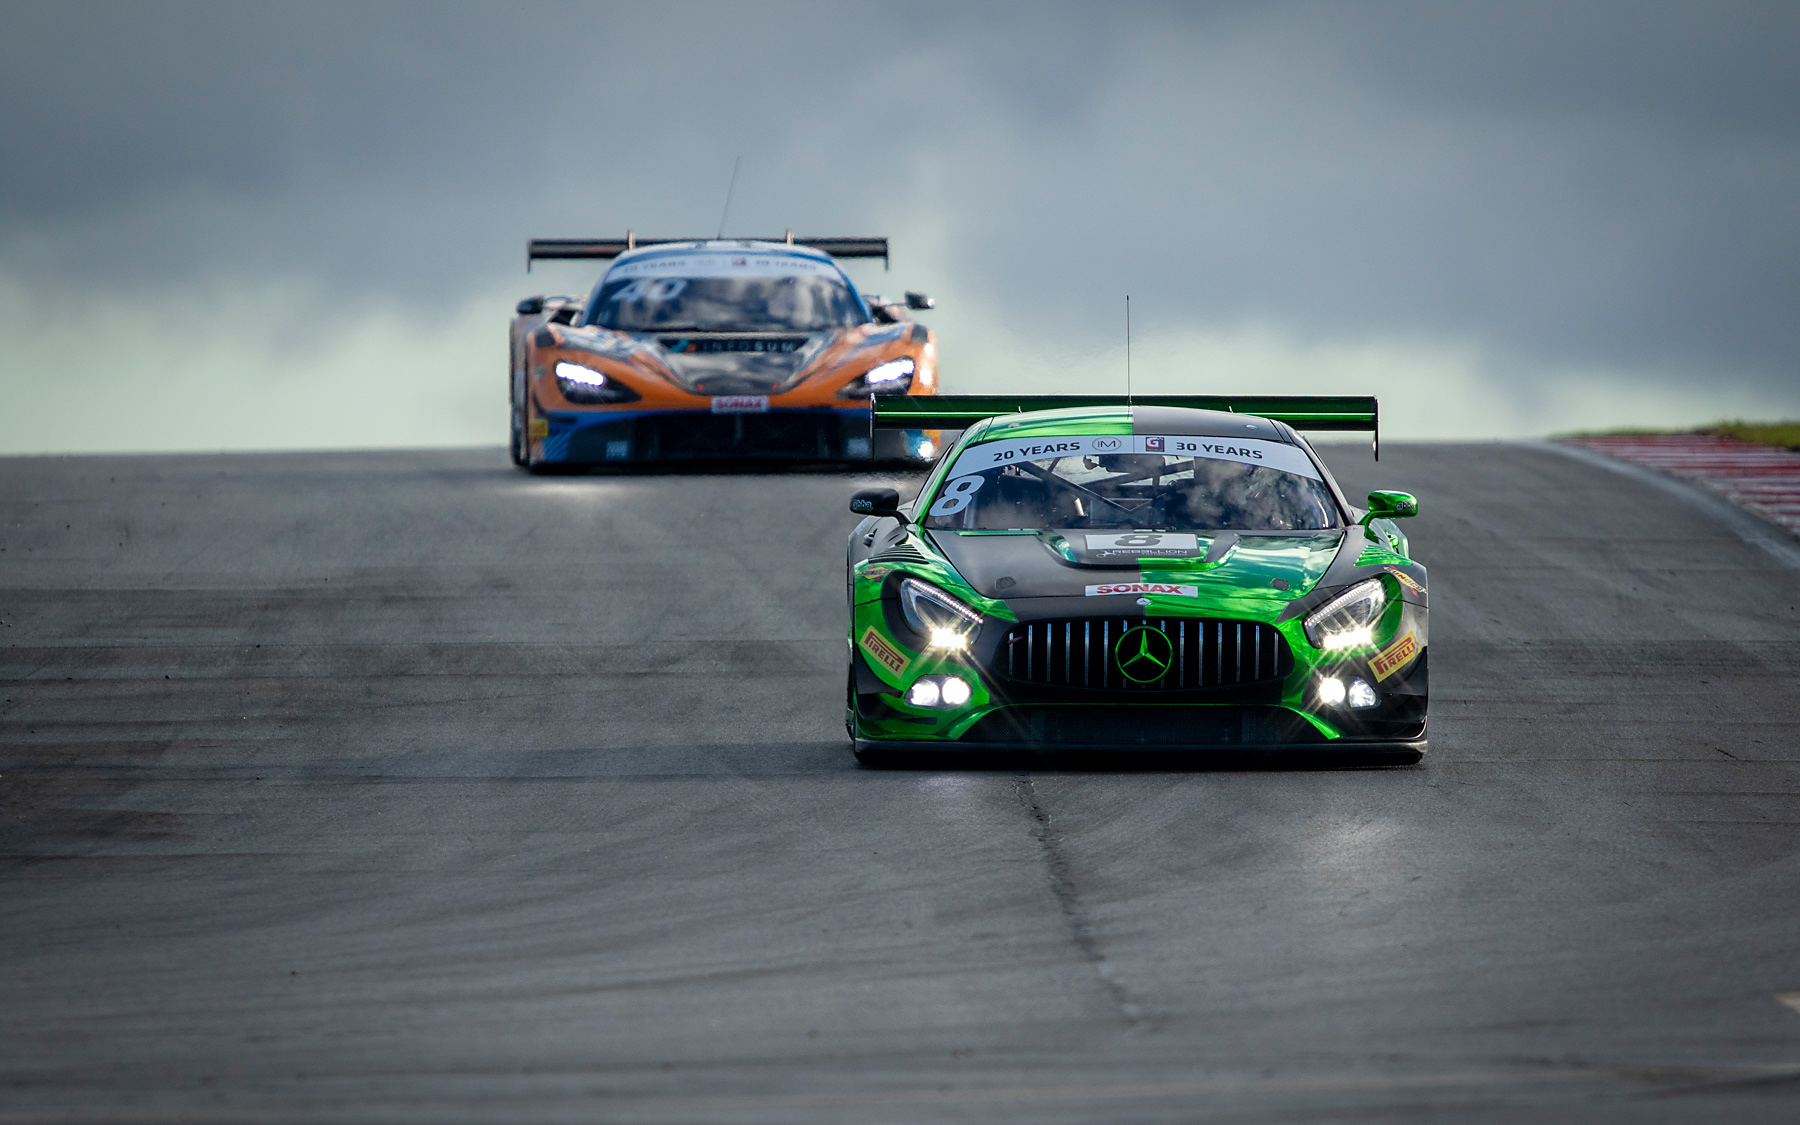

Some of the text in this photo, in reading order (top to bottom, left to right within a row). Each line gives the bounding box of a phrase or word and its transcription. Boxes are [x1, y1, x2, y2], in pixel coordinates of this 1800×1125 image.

[702, 340, 795, 352] INFOSUM
[993, 441, 1081, 462] 20 YEARS
[1176, 442, 1263, 459] 30 YEARS
[929, 475, 985, 516] 8
[1114, 534, 1163, 547] 8
[1096, 584, 1183, 595] SONAX
[864, 630, 905, 672] PIRELLI
[1373, 636, 1416, 675] PIRELLI
